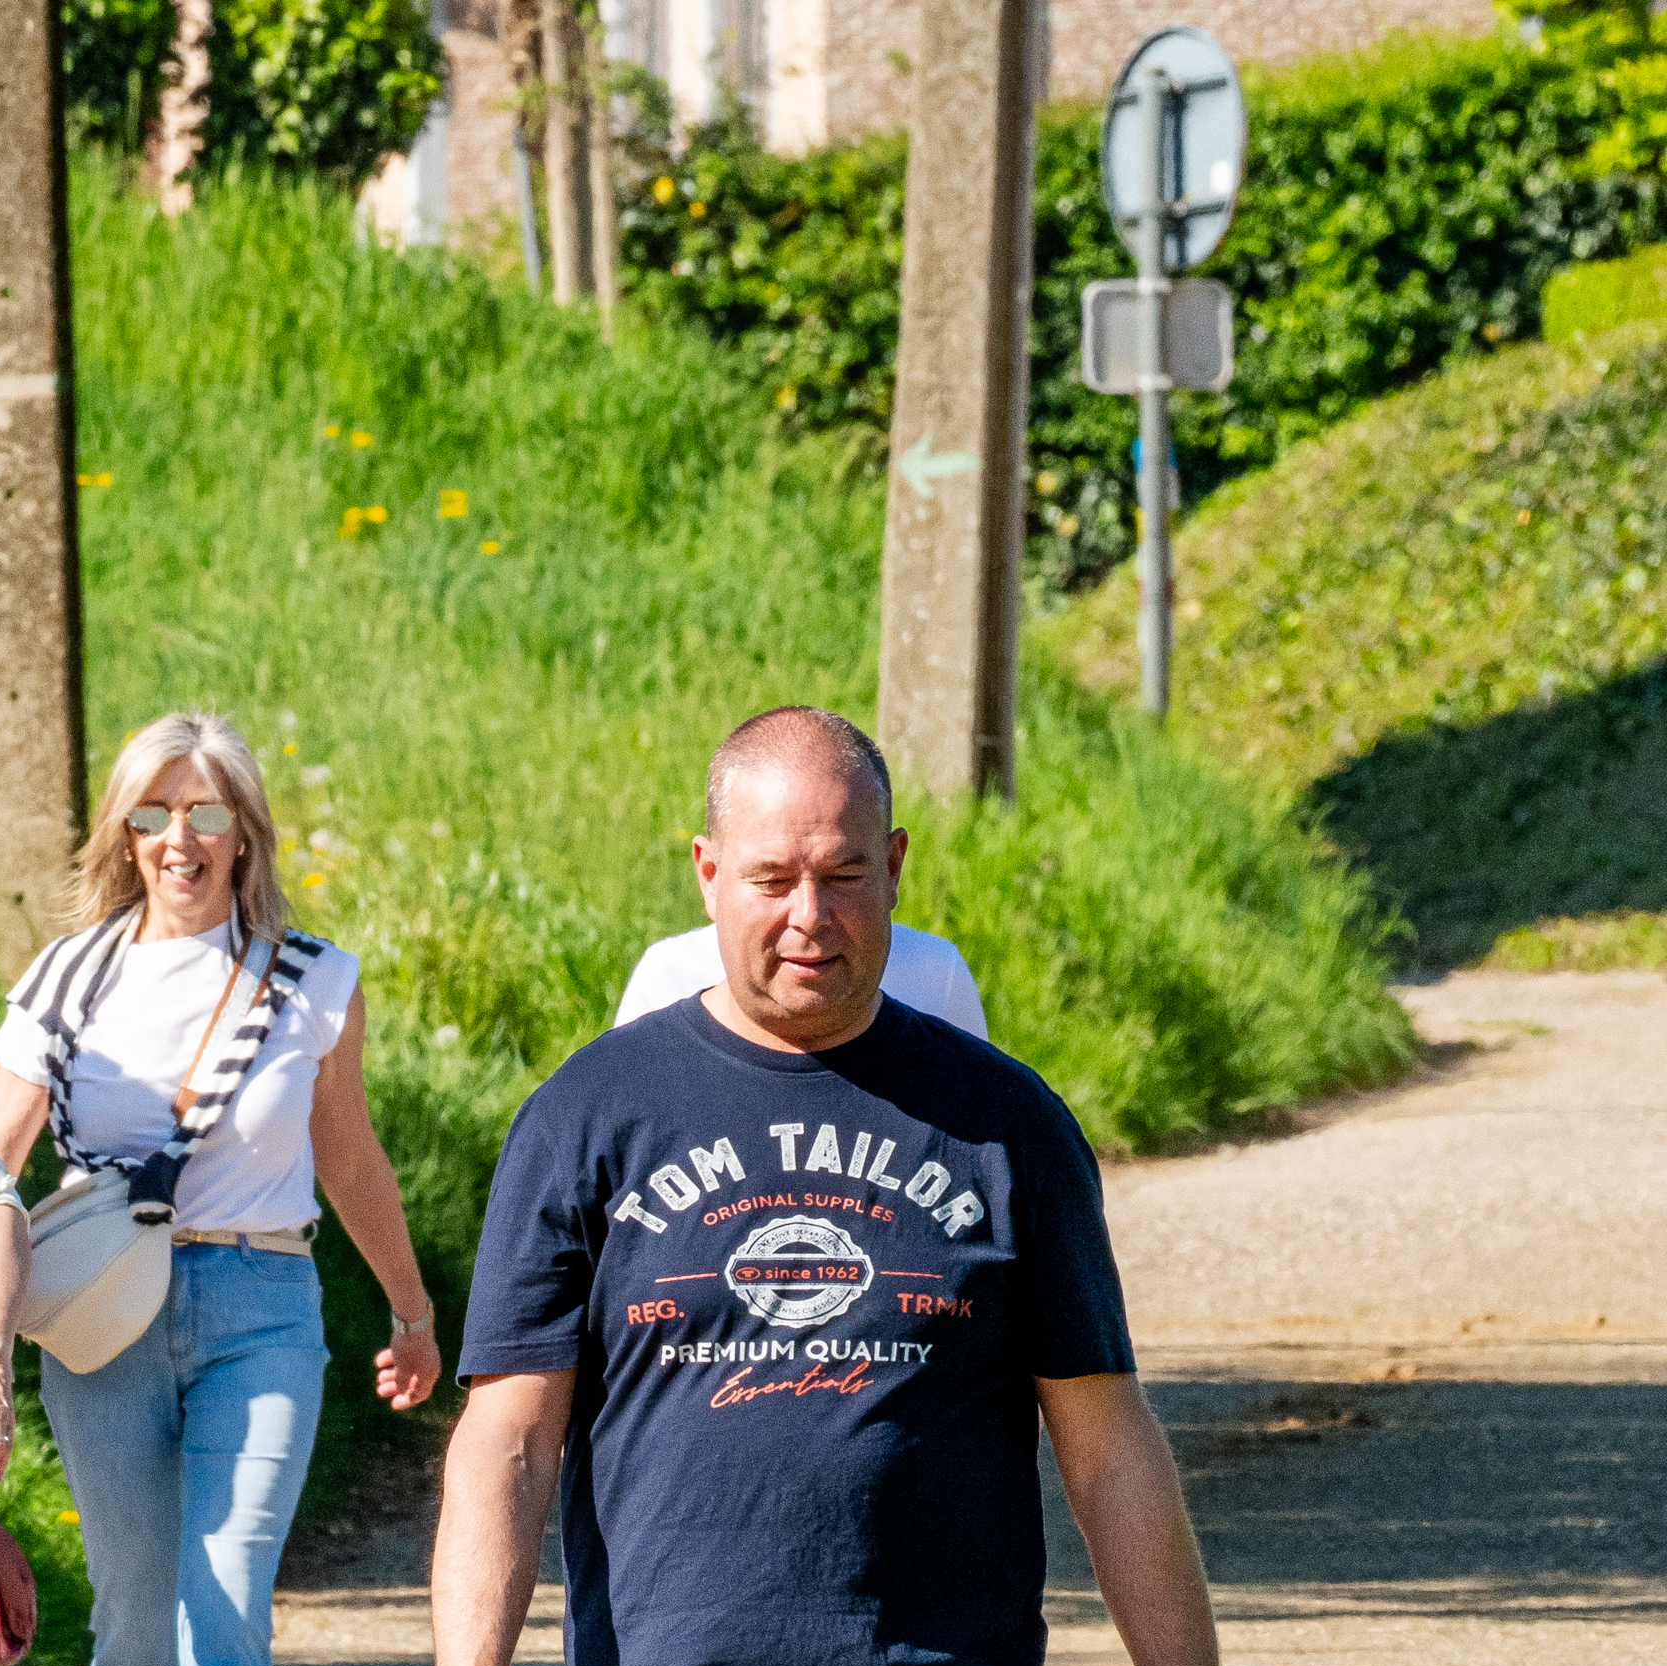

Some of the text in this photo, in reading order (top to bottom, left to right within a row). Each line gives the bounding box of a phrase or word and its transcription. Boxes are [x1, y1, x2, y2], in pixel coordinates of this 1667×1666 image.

[614, 1123, 985, 1238] TOM TAILOR
[703, 1193, 896, 1226] ORIGINAL SUPPLES
[765, 1266, 859, 1280] since 1962
[627, 1299, 685, 1325] REG.
[897, 1293, 973, 1318] TRMK
[660, 1340, 933, 1365] PREMIUM QUALITY
[709, 1361, 875, 1408] Essentials
